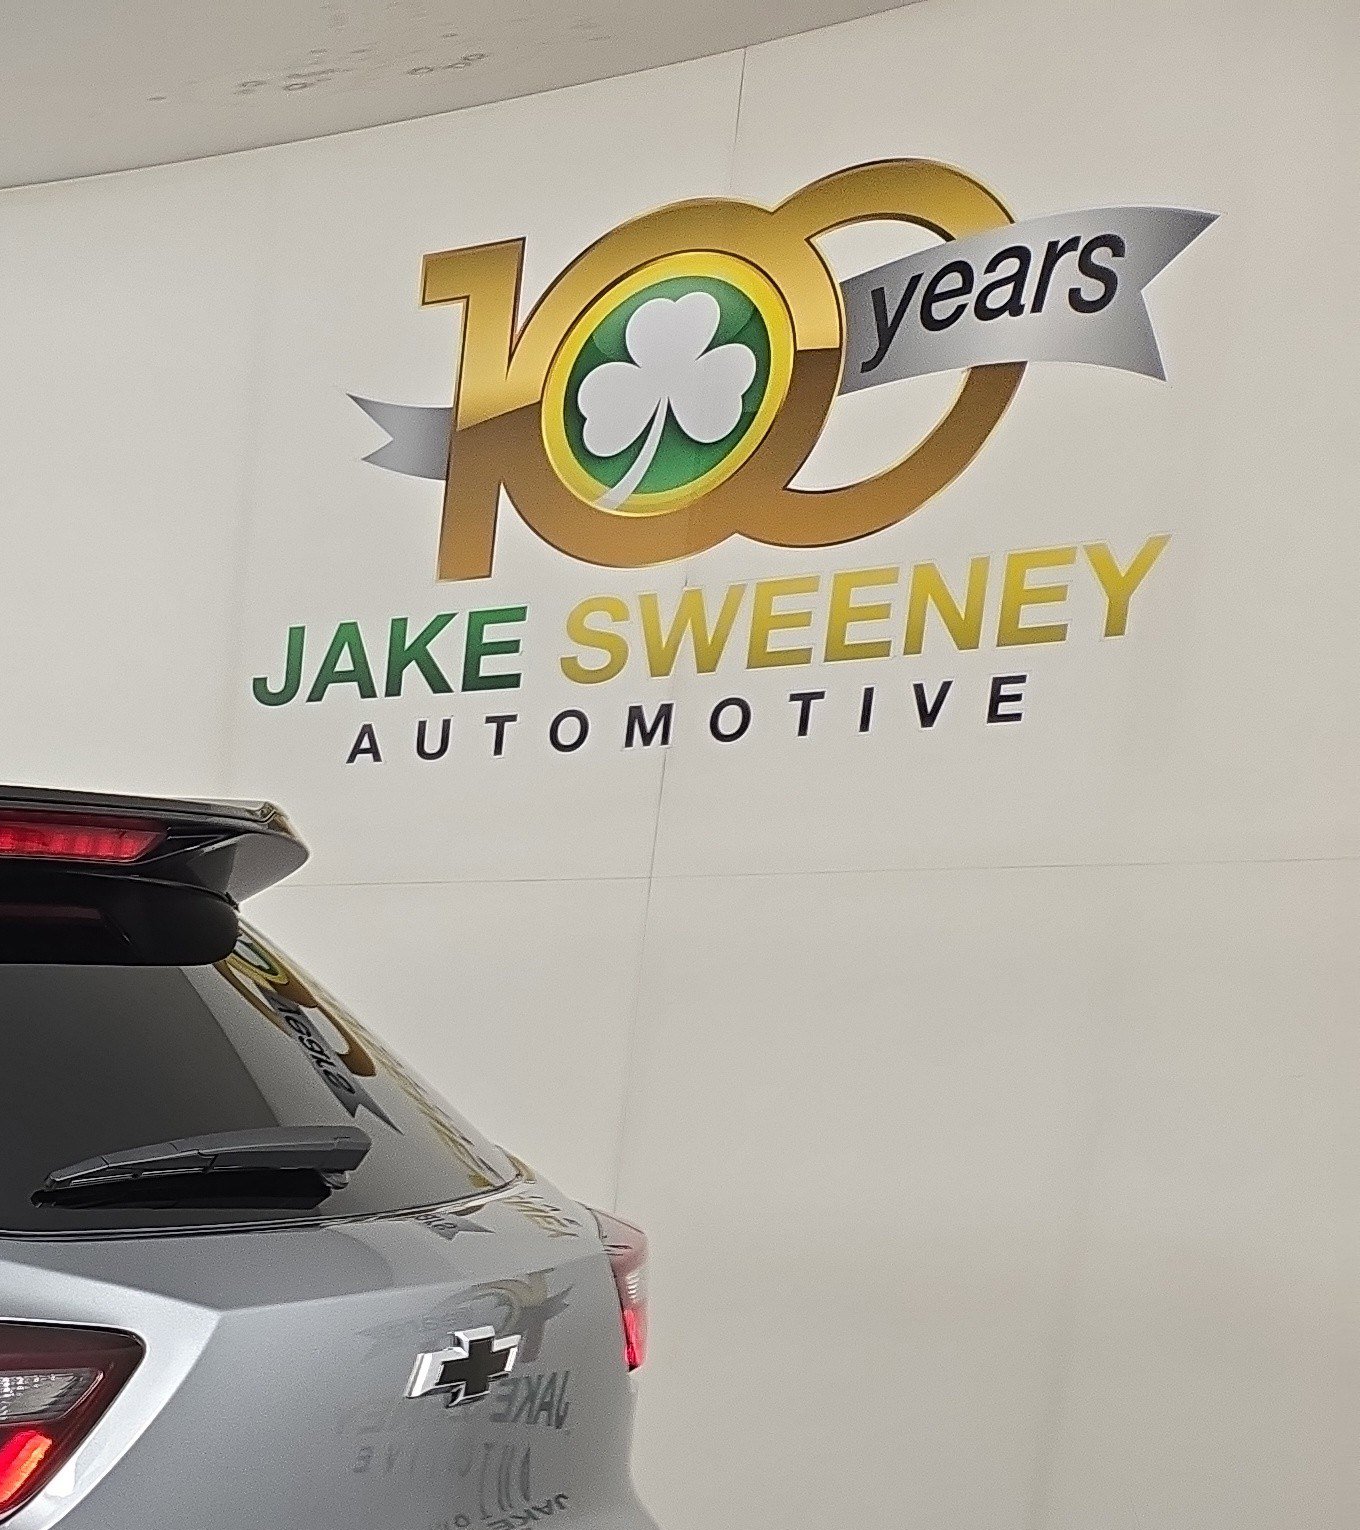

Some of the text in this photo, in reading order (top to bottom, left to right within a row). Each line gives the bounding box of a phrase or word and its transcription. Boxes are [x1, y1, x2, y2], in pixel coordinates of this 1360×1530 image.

[861, 233, 1125, 373] years
[252, 534, 1171, 707] JAKE SWEENEY
[347, 674, 1027, 764] AUTOMOTIVE
